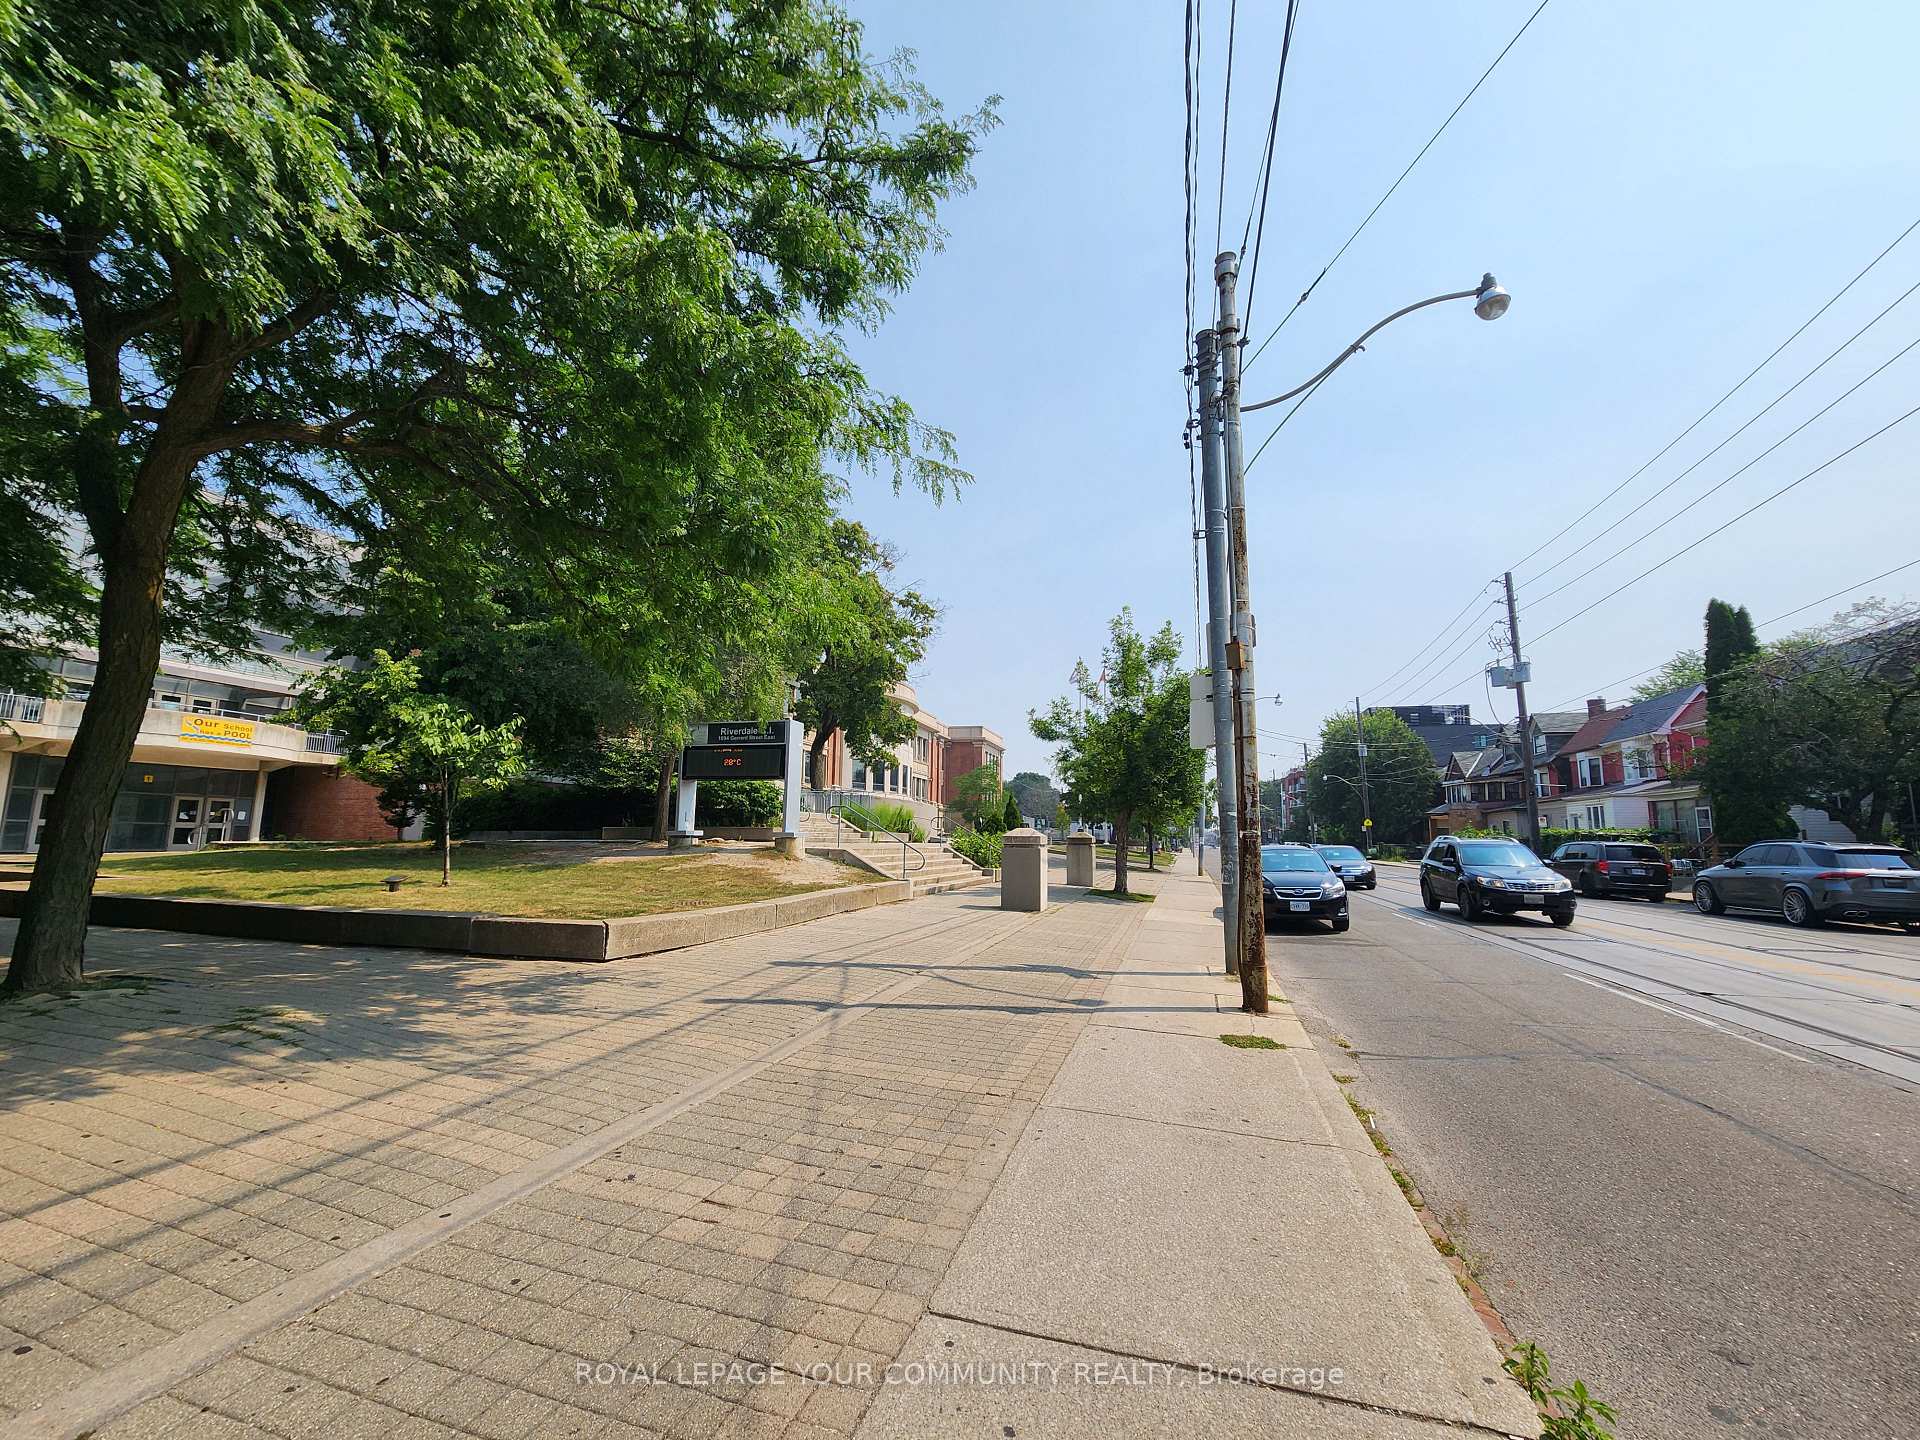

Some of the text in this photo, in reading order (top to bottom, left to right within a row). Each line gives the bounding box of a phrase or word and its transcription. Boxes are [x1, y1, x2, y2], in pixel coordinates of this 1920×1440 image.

[194, 718, 253, 732] Our School
[223, 730, 252, 739] POOL
[720, 727, 758, 735] Riverdale
